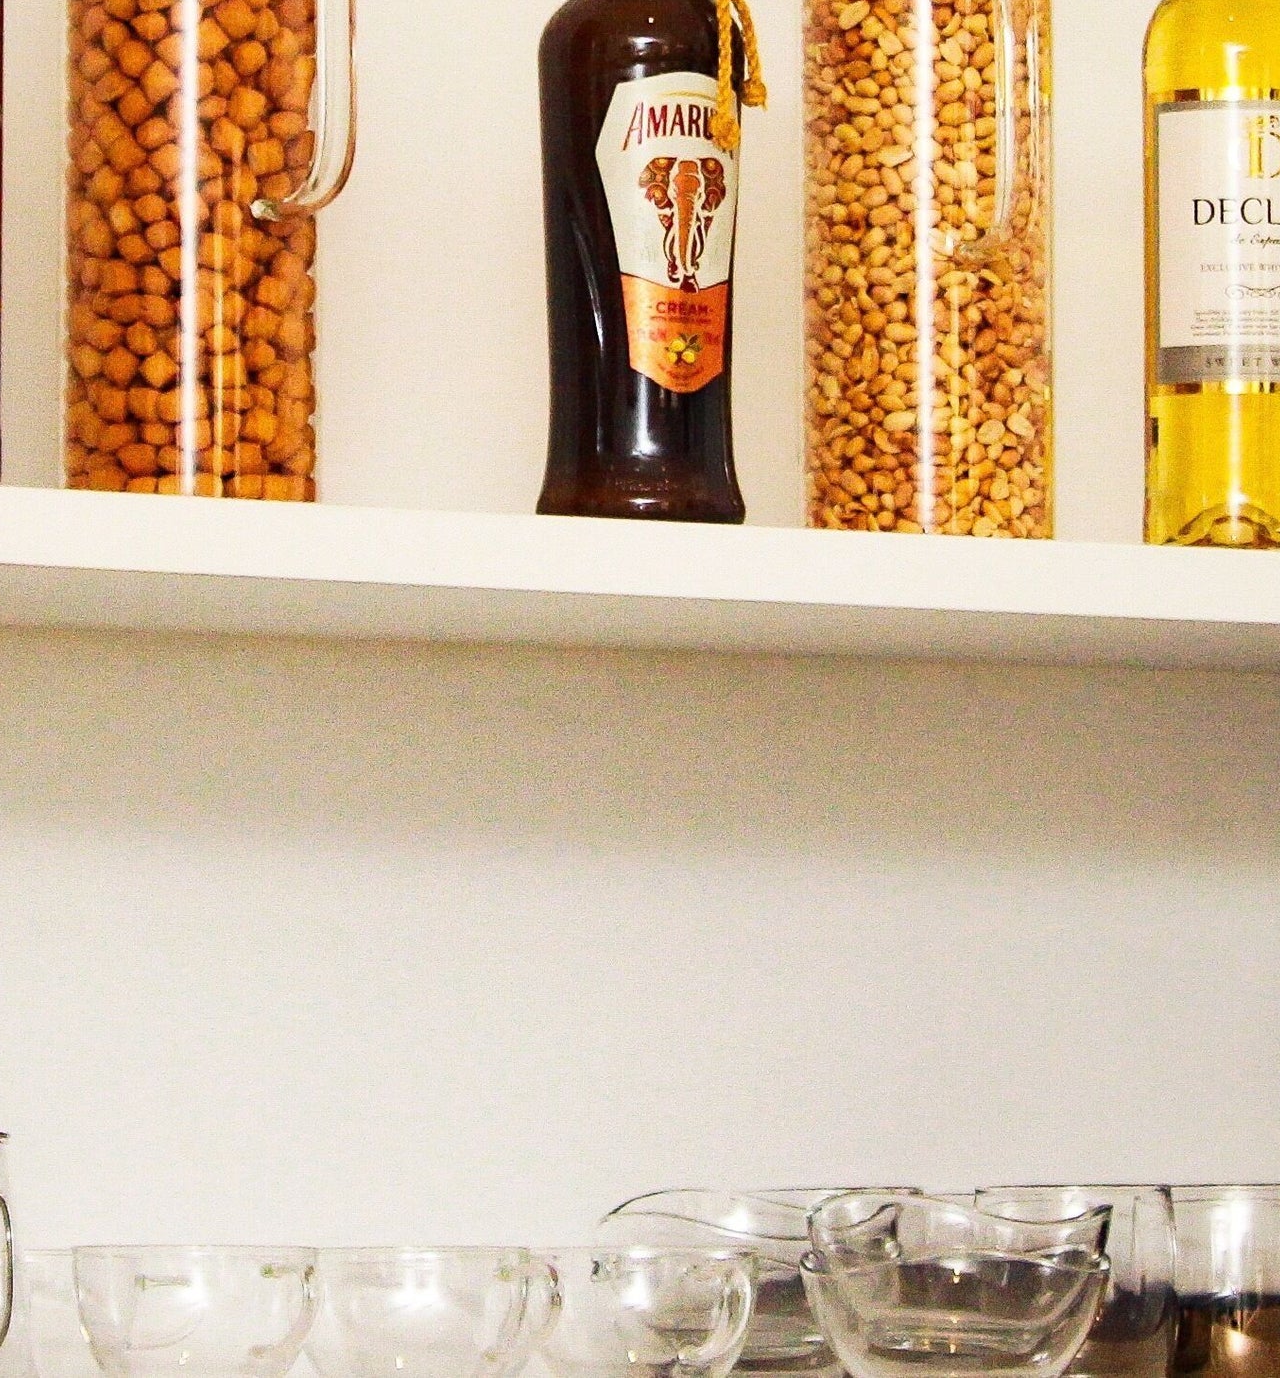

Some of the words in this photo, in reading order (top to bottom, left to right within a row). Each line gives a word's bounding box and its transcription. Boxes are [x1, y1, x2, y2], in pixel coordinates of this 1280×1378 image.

[621, 102, 734, 159] AMARU
[1199, 263, 1255, 273] EXCLIVE
[1205, 357, 1262, 369] SWET
